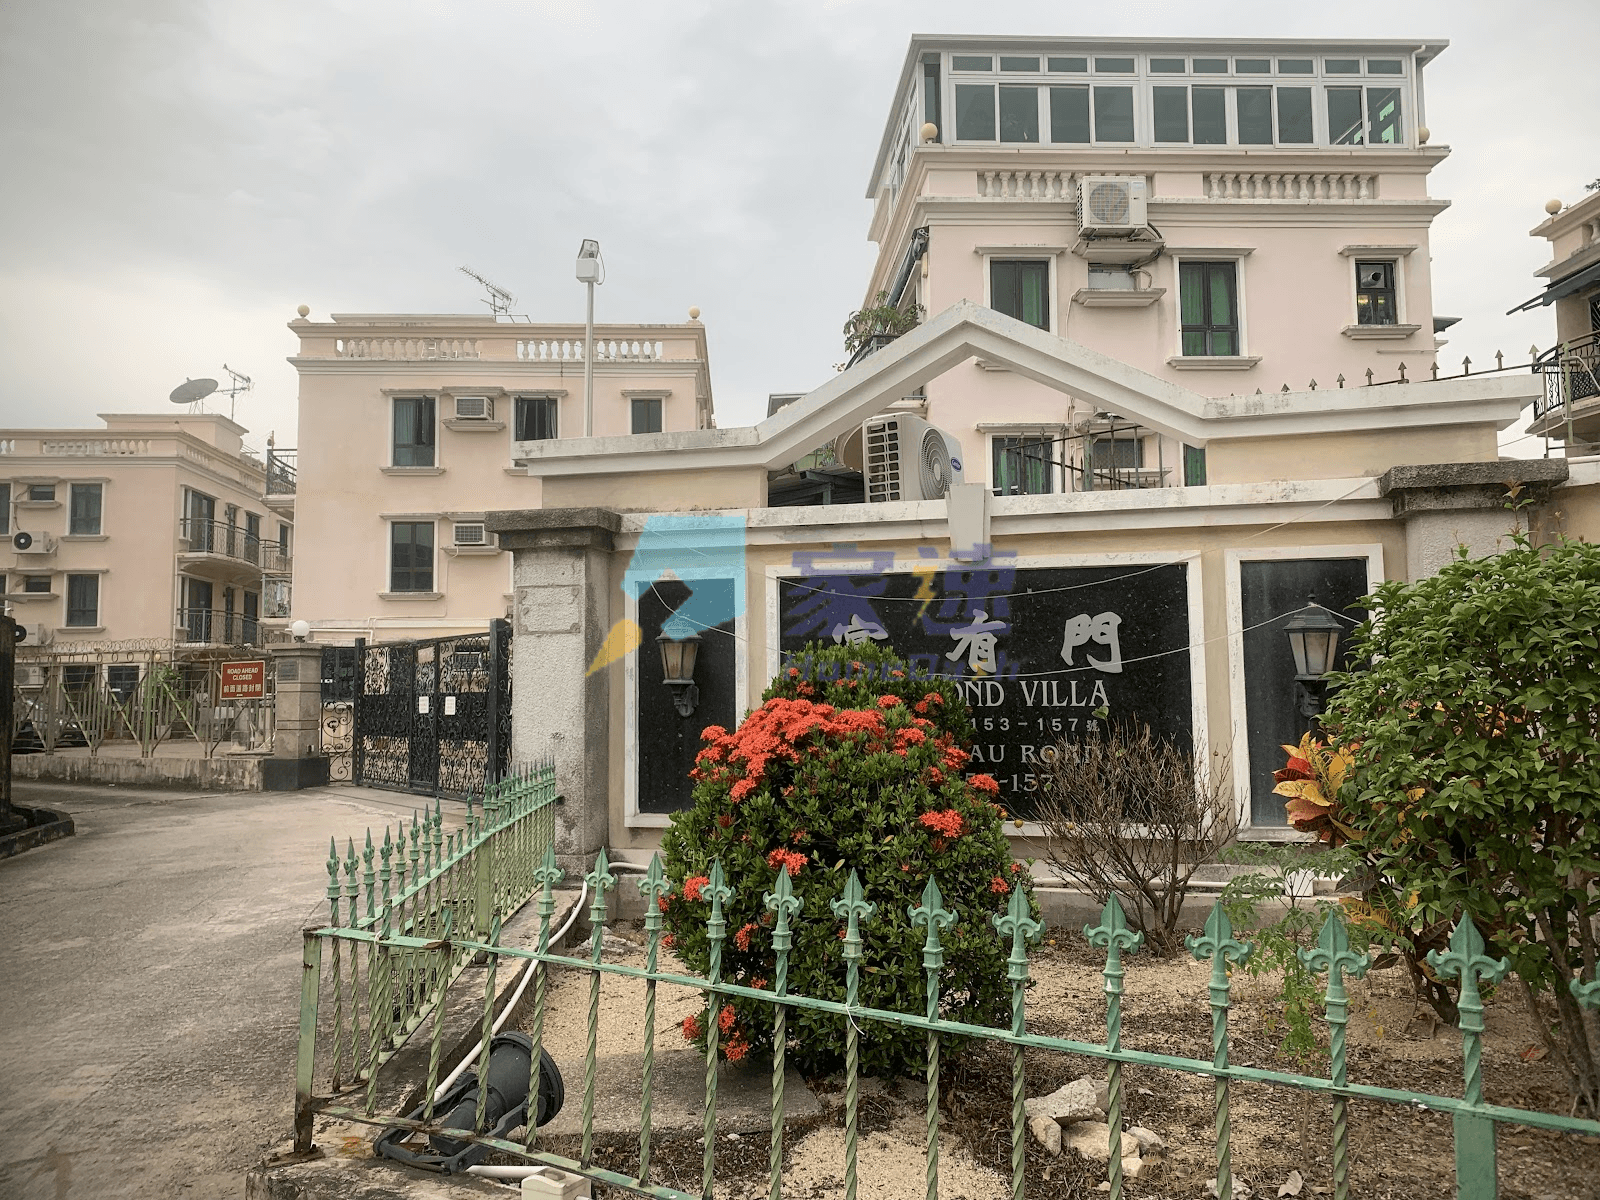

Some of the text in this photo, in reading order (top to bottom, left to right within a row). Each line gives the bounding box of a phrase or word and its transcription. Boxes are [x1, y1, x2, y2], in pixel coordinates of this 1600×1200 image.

[1019, 679, 1111, 707] VILLA
[951, 744, 1103, 764] AU RO
